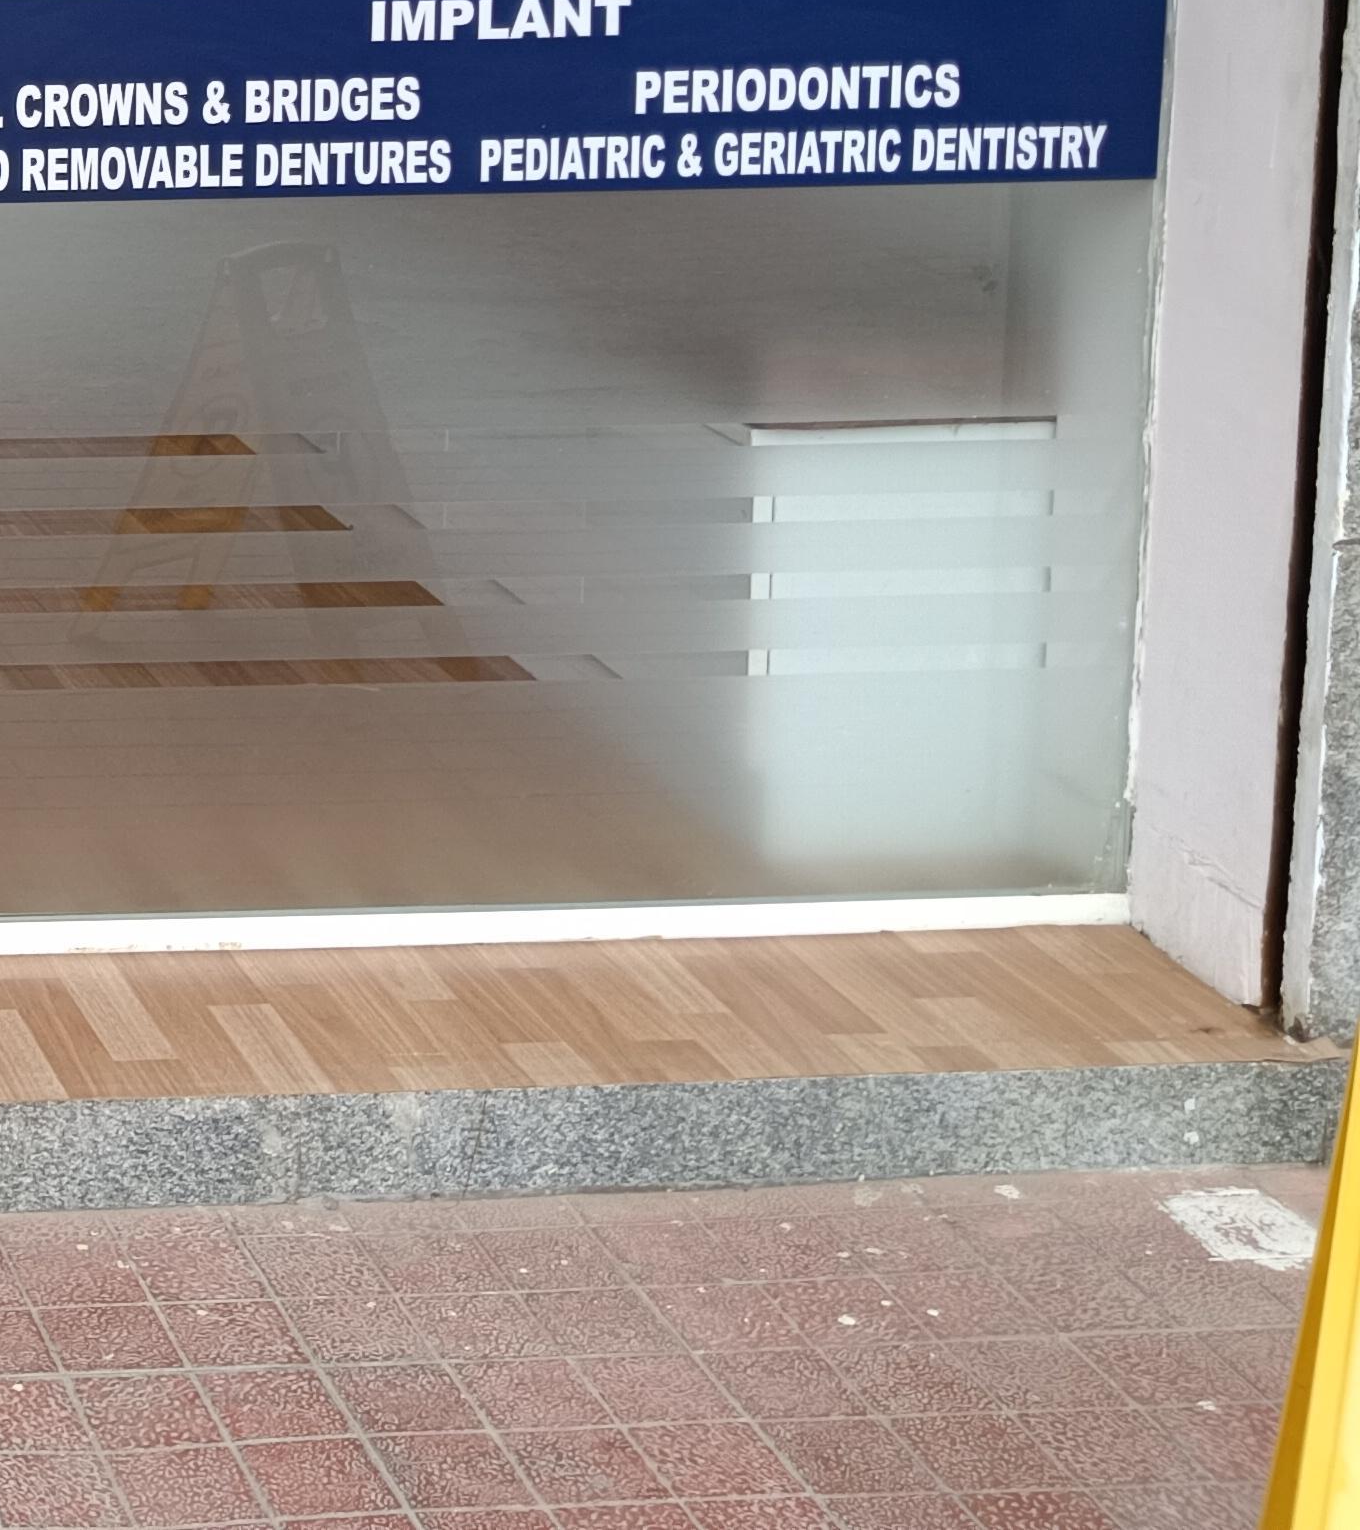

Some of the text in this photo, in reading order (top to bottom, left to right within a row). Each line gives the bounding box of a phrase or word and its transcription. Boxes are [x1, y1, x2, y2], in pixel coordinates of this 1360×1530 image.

[15, 81, 189, 129] CROWNS
[202, 80, 231, 125] &
[245, 76, 421, 124] BRIDGES
[635, 63, 961, 115] PERIODONTICS
[22, 143, 244, 192] REMOVABLE
[255, 139, 452, 187] DENTURES
[480, 124, 1108, 183] PEDIATRIC & GERIATRIC DENTISTRY
